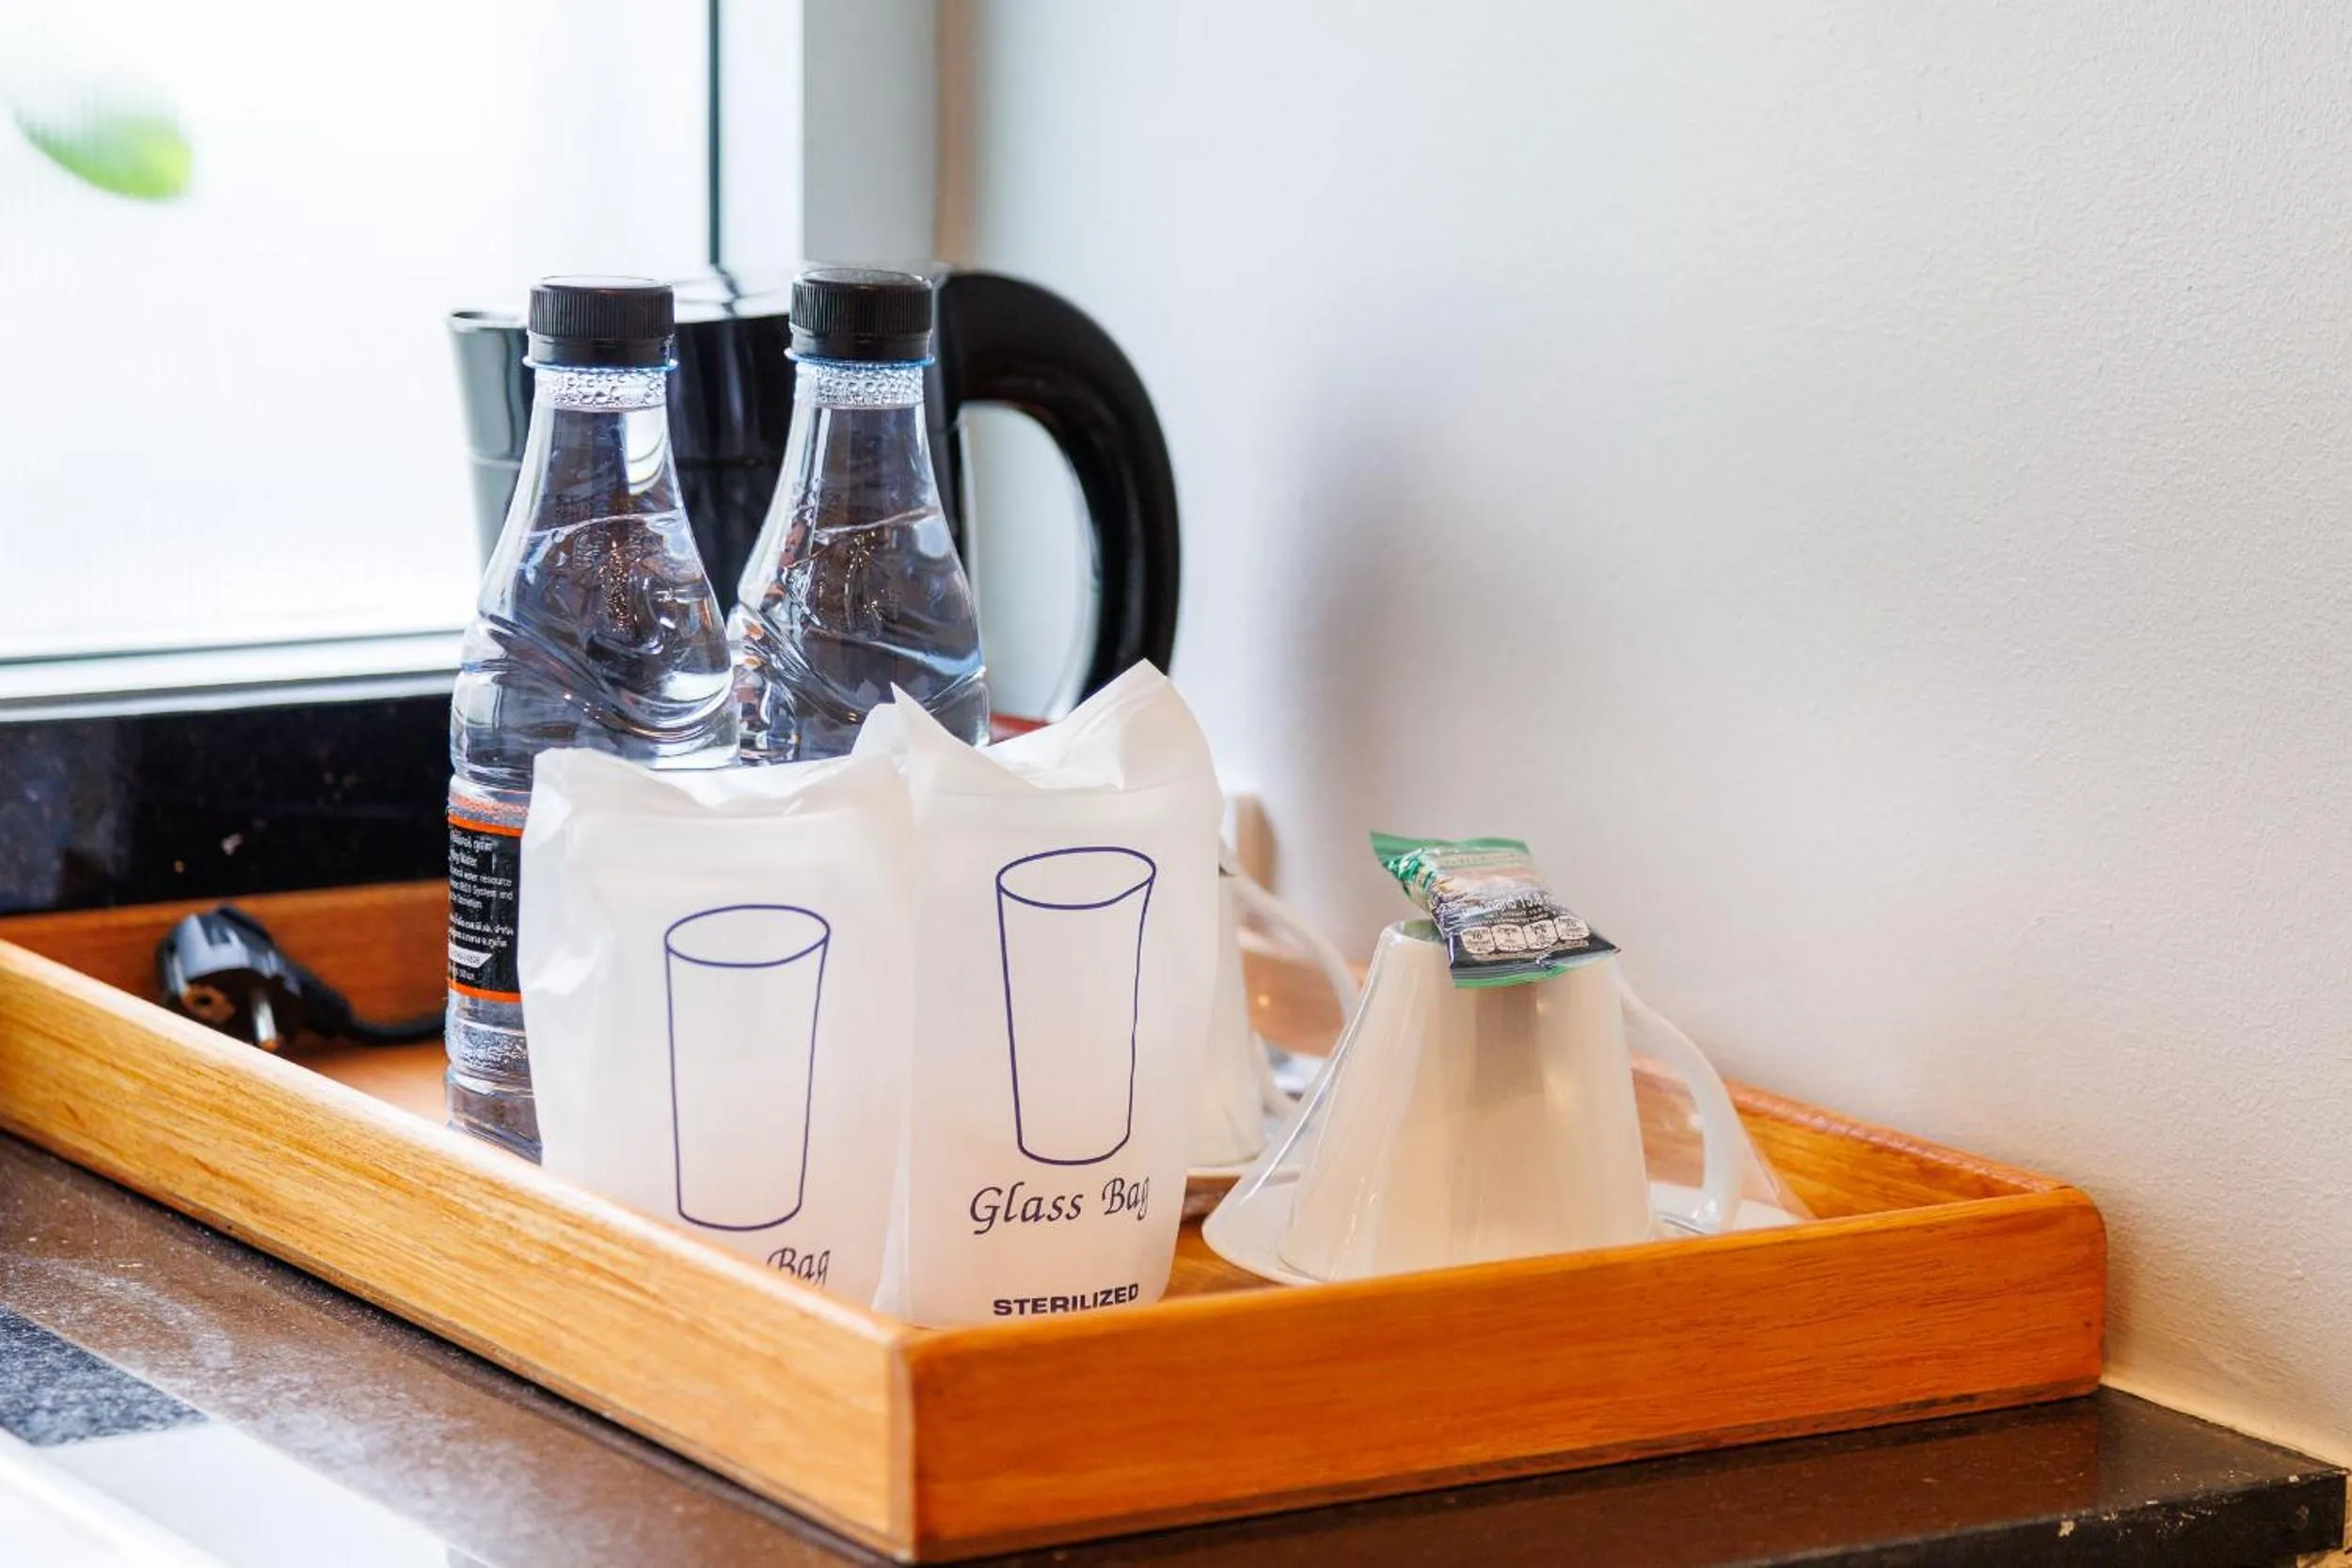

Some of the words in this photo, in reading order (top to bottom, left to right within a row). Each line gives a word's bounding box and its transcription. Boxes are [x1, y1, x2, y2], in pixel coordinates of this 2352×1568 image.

[969, 1180, 1084, 1235] Glass
[1101, 1177, 1151, 1221] Bag
[766, 1247, 831, 1288] Bag
[993, 1283, 1139, 1316] STERILIZED
